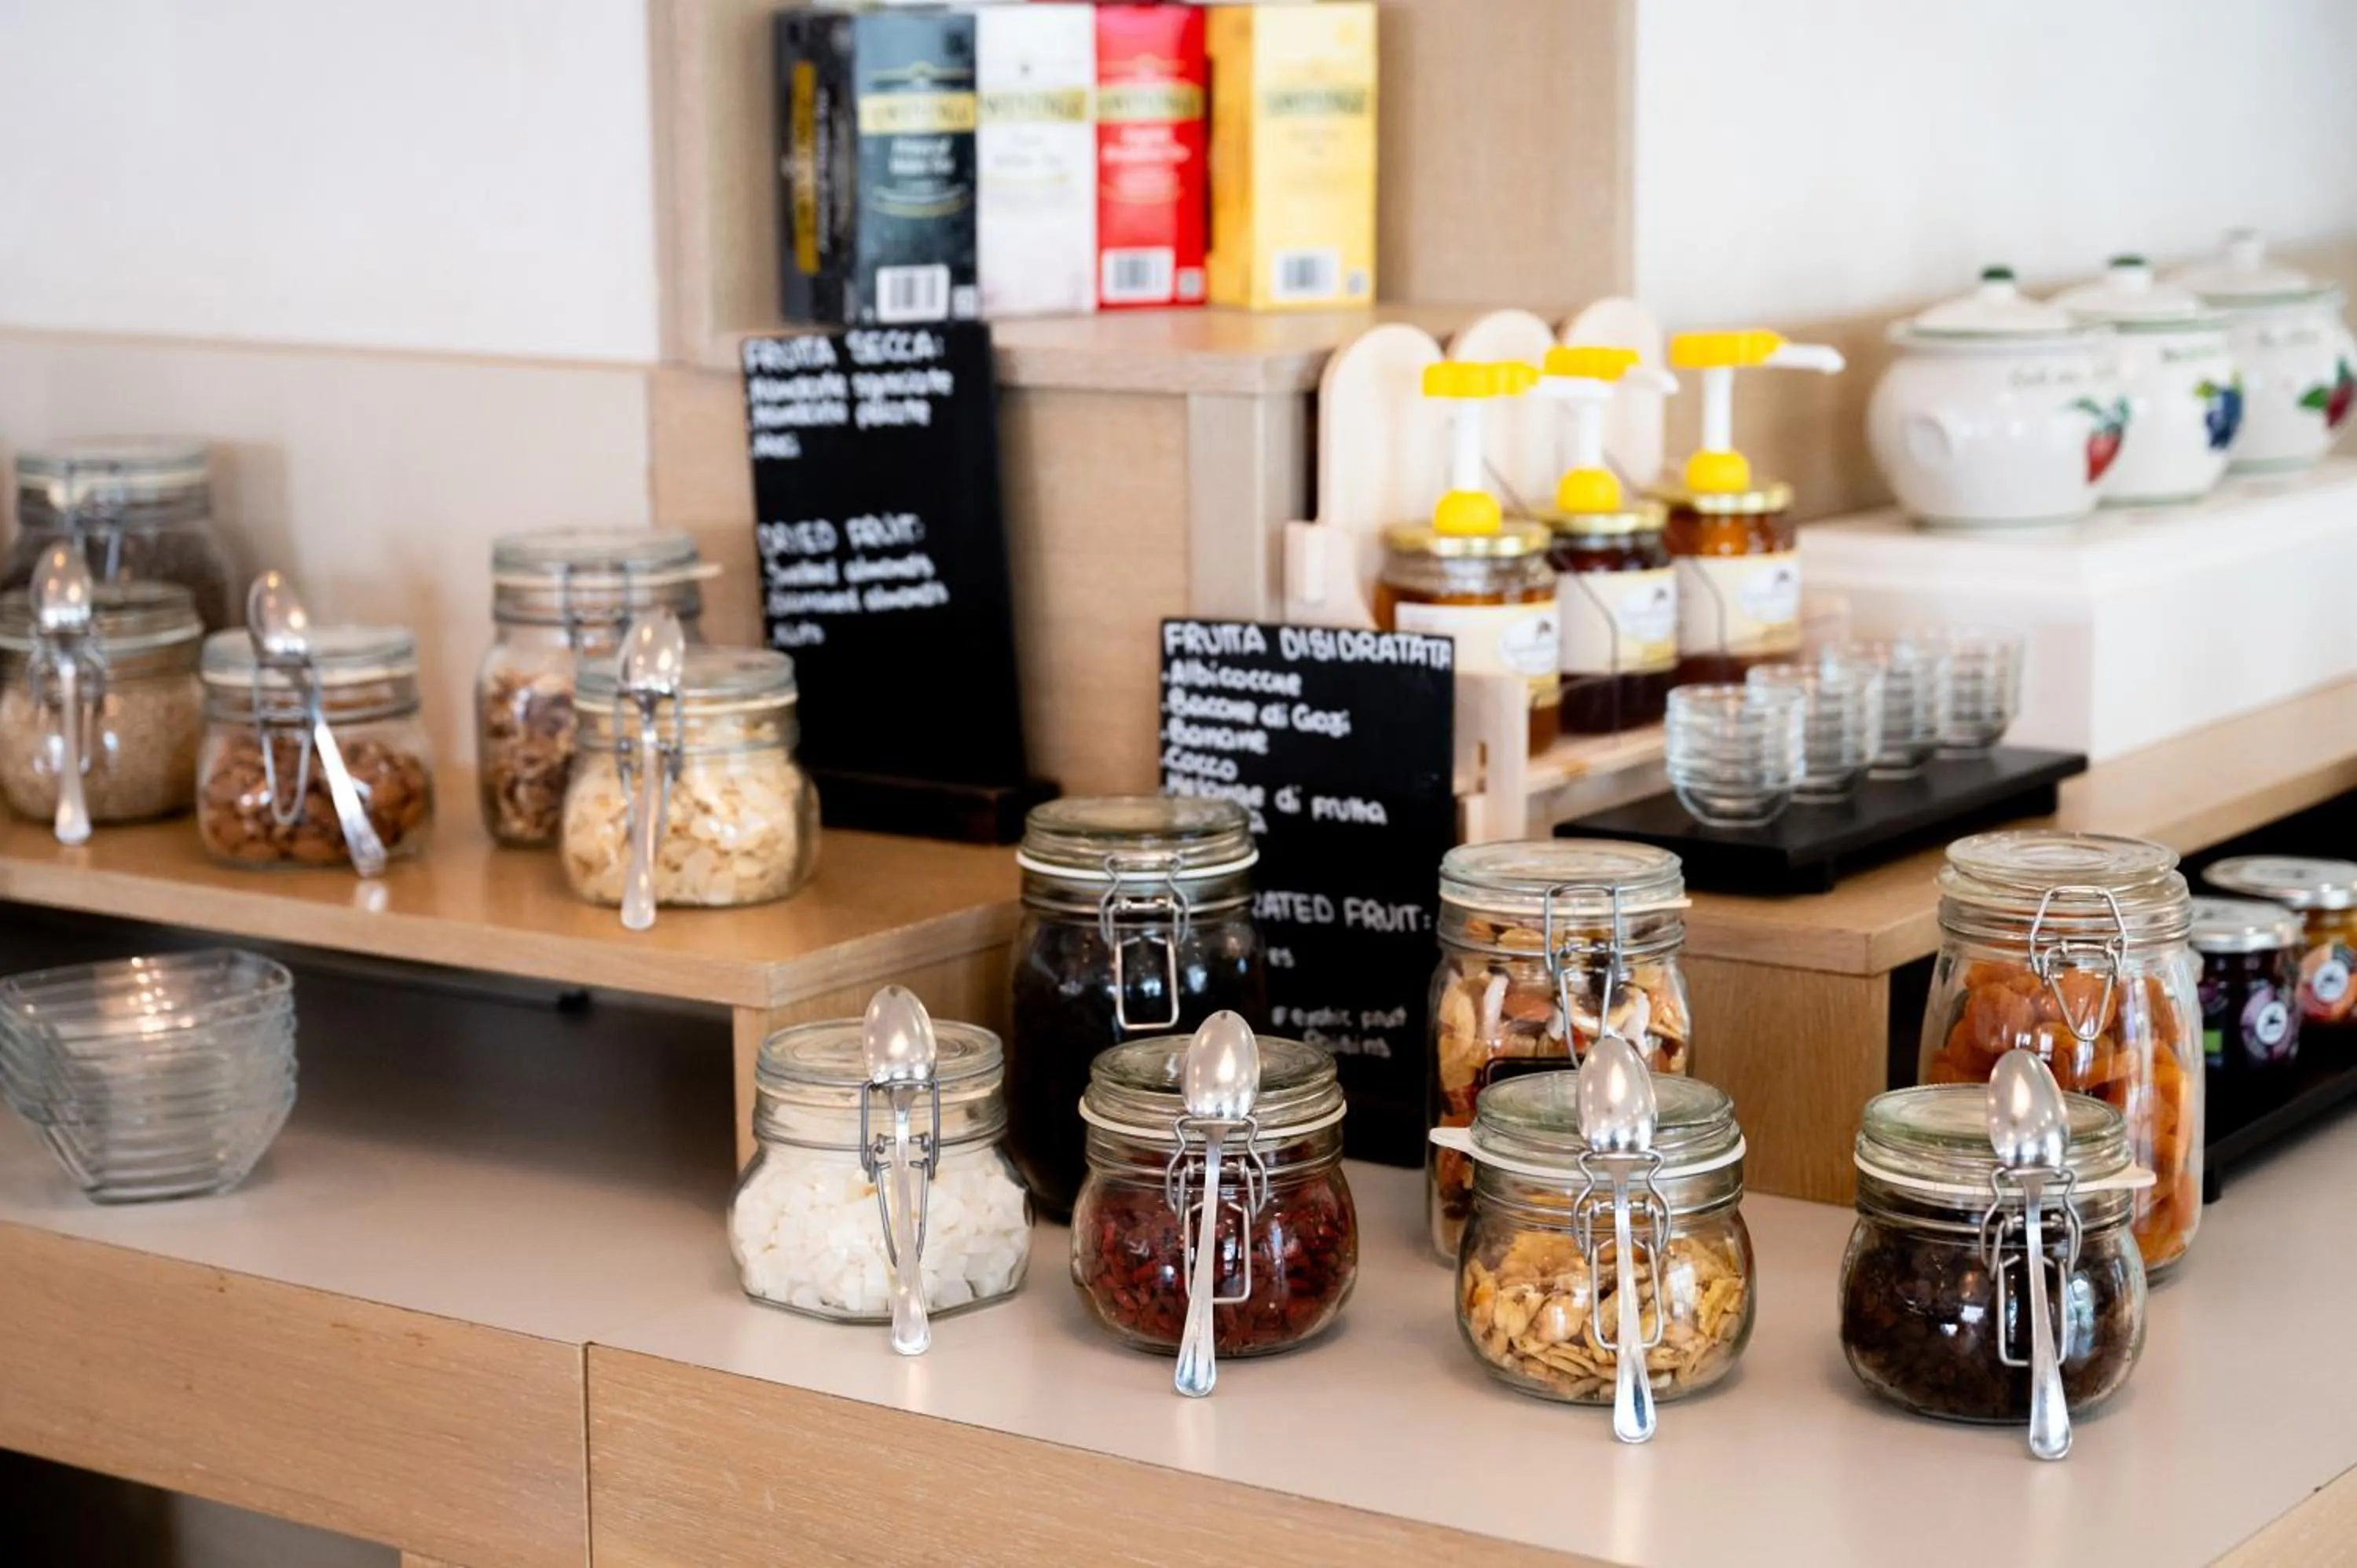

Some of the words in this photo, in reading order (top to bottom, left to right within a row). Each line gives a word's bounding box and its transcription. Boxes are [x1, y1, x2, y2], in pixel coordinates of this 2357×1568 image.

[1279, 627, 1453, 670] DISIDRATATA
[1259, 702, 1289, 730] di
[1274, 784, 1302, 814] di
